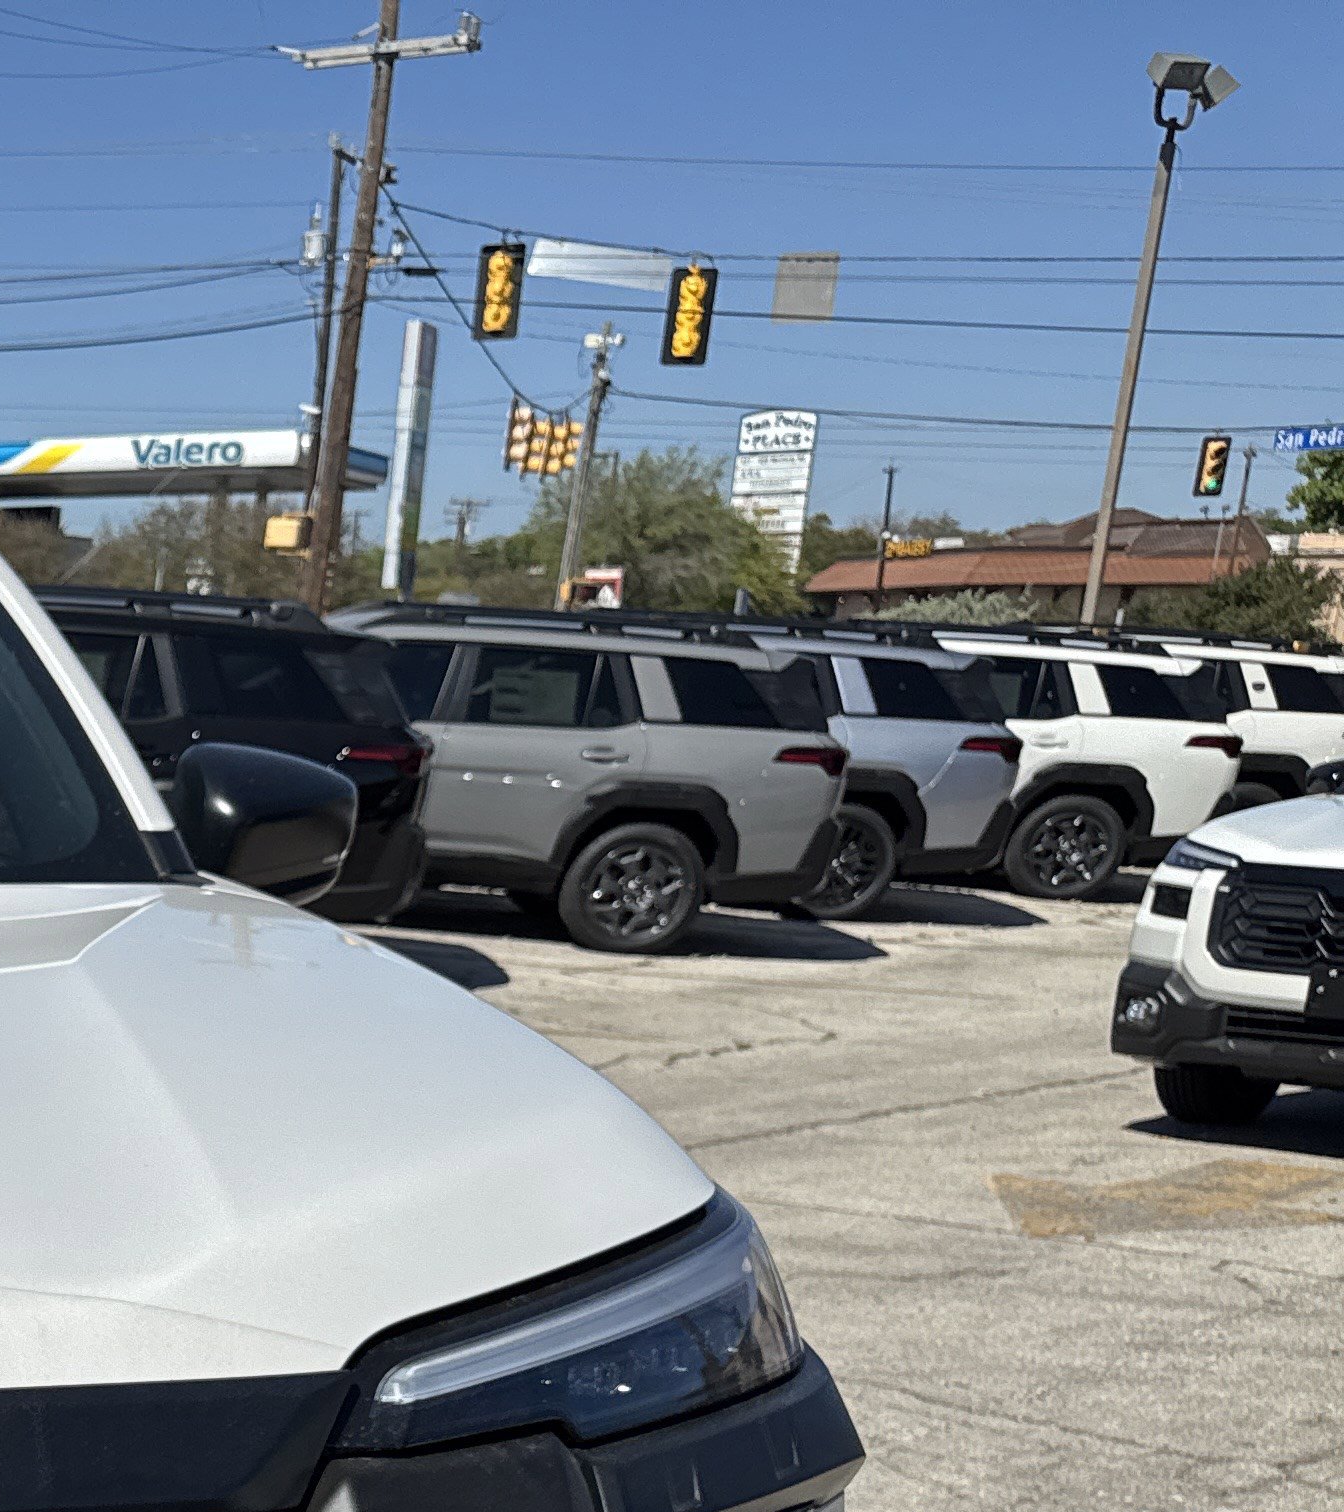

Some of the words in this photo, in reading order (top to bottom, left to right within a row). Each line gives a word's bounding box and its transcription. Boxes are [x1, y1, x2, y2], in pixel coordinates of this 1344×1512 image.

[752, 432, 802, 449] PLACE
[1276, 430, 1304, 449] San
[1309, 427, 1344, 447] Pedr
[131, 438, 244, 465] Valero
